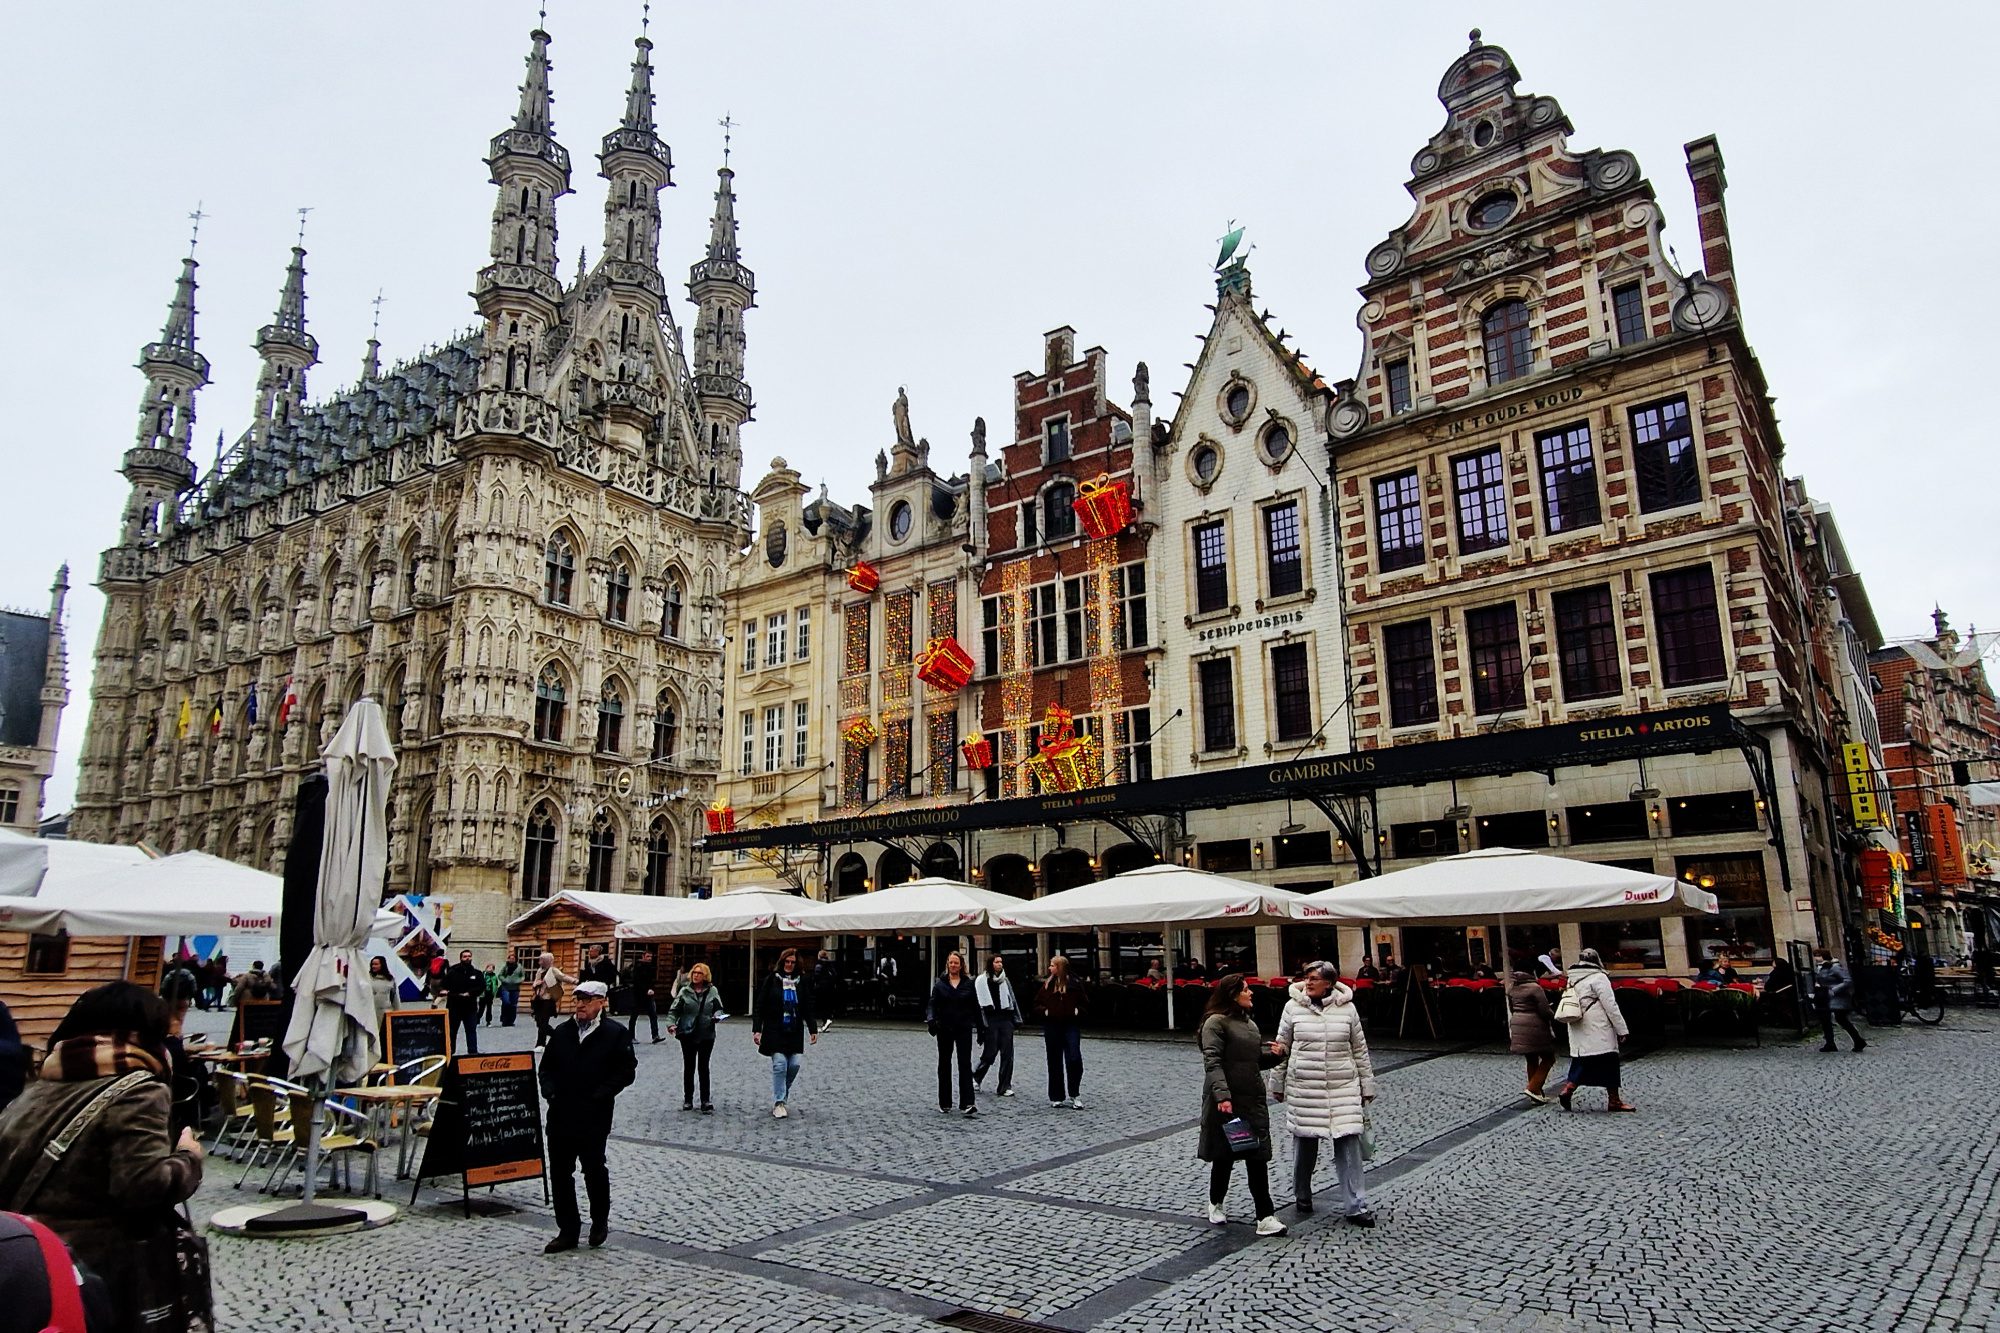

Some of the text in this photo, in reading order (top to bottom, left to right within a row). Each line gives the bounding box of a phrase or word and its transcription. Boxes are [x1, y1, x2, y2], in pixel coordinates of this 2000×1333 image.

[1448, 421, 1464, 435] IN
[1486, 403, 1529, 425] OUDE
[1534, 388, 1583, 411] WOUD
[1580, 716, 1711, 742] STELLA ARTOIS
[1269, 757, 1375, 783] GAMBRINUS
[1852, 748, 1870, 813] FRITUUR
[1042, 793, 1116, 810] STELLA ARTOIS
[811, 823, 847, 837] NOTRE
[710, 834, 761, 846] STELLA ARTOIS
[1624, 889, 1658, 901] Duvel
[1224, 904, 1249, 914] Duvel
[1303, 907, 1330, 917] Duvel
[229, 914, 272, 929] Duvel
